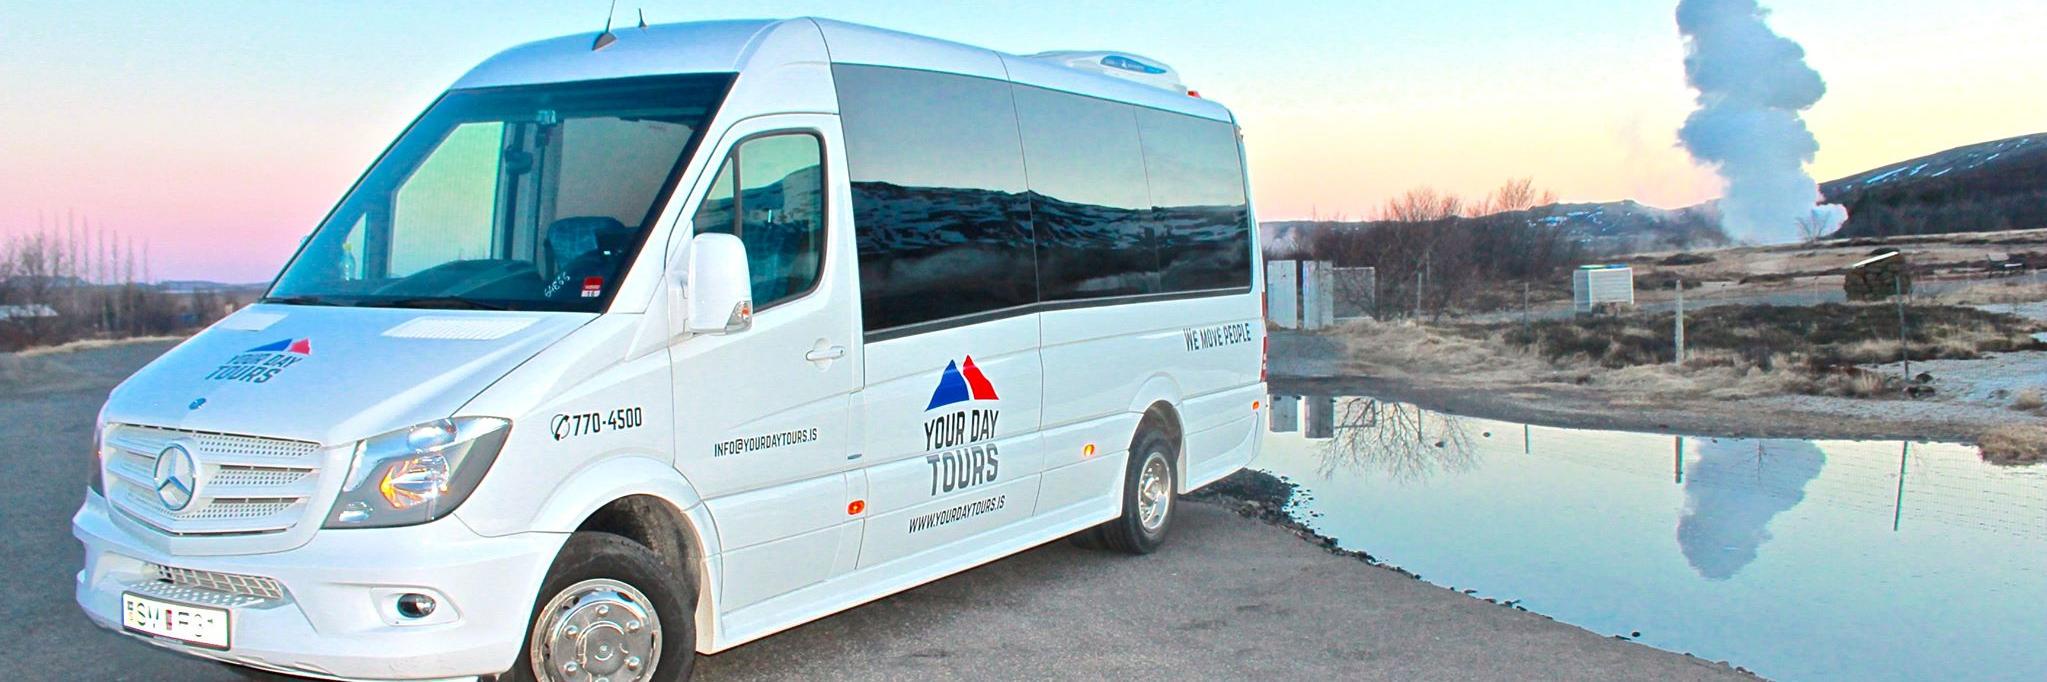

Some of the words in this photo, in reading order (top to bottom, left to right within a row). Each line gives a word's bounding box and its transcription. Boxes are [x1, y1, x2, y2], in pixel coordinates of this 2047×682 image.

[1199, 326, 1223, 349] MOVE
[1222, 322, 1251, 346] PEOPLE
[204, 365, 283, 384] TOURS
[262, 354, 303, 368] DAY
[572, 406, 643, 436] 770-4500
[924, 410, 966, 452] YOUR
[969, 408, 999, 443] DAY
[714, 427, 818, 457] INFO@YOURDAYTOURS.IS
[926, 443, 999, 497] TOURS
[908, 494, 1006, 534] WWW.YOURDAYTOURS.IS
